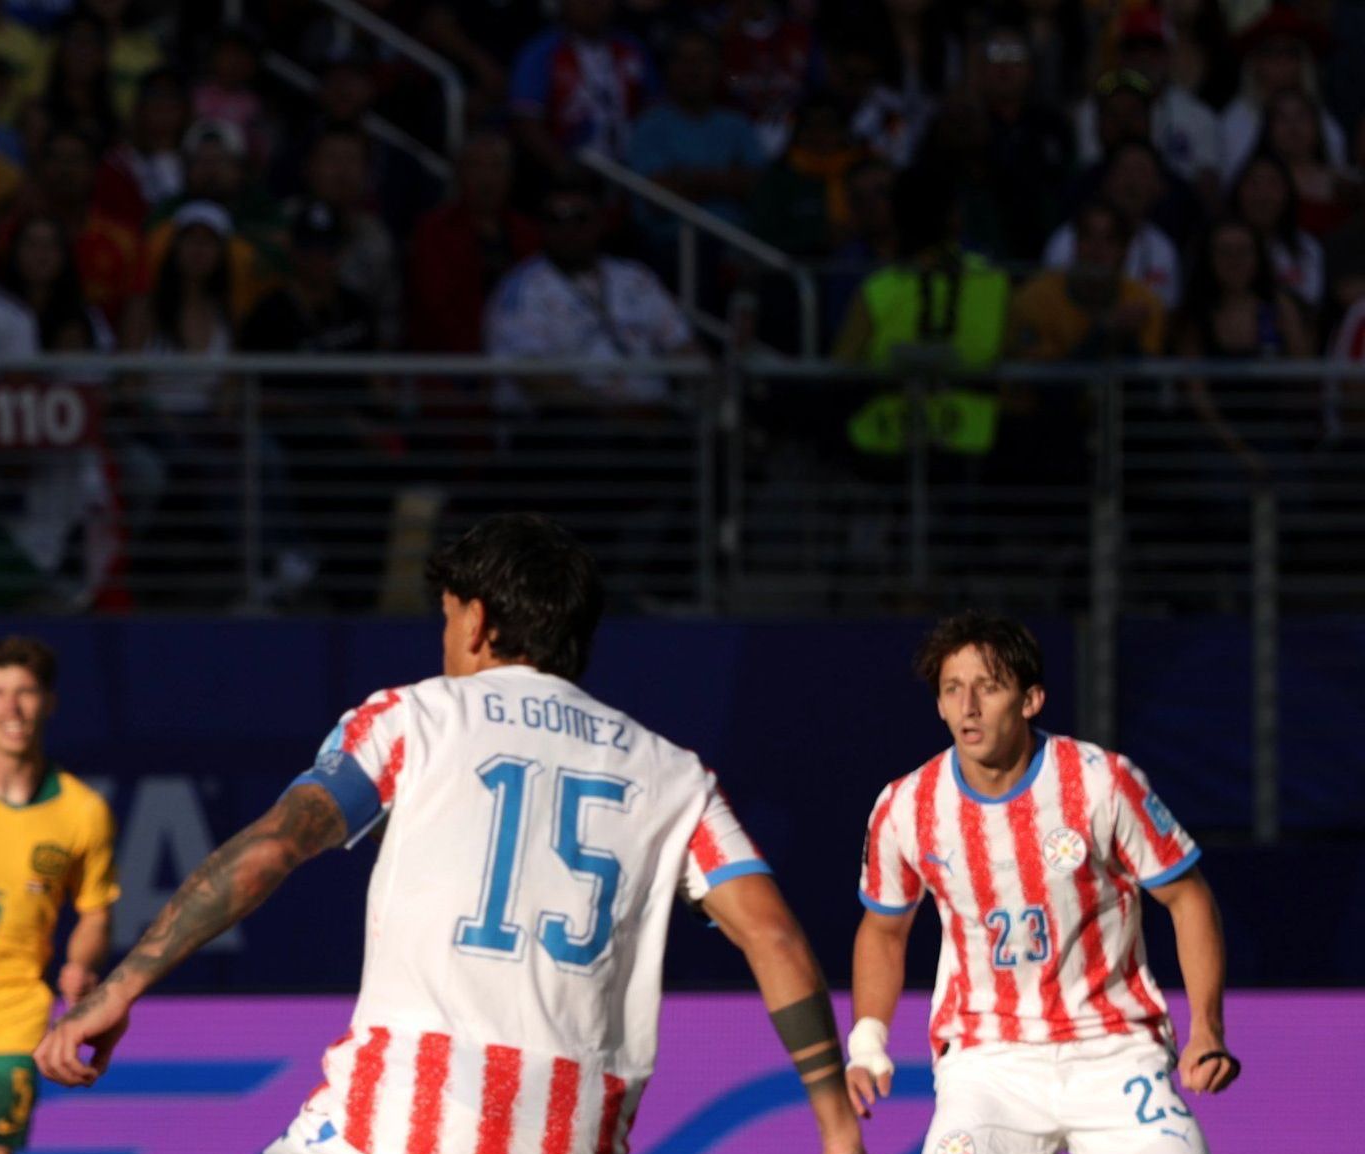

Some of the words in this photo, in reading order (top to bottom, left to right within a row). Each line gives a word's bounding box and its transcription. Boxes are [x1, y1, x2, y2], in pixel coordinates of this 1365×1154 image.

[483, 692, 515, 727] G.
[521, 694, 630, 754] GÓMEZ
[452, 753, 643, 977] 15
[985, 904, 1051, 968] 23
